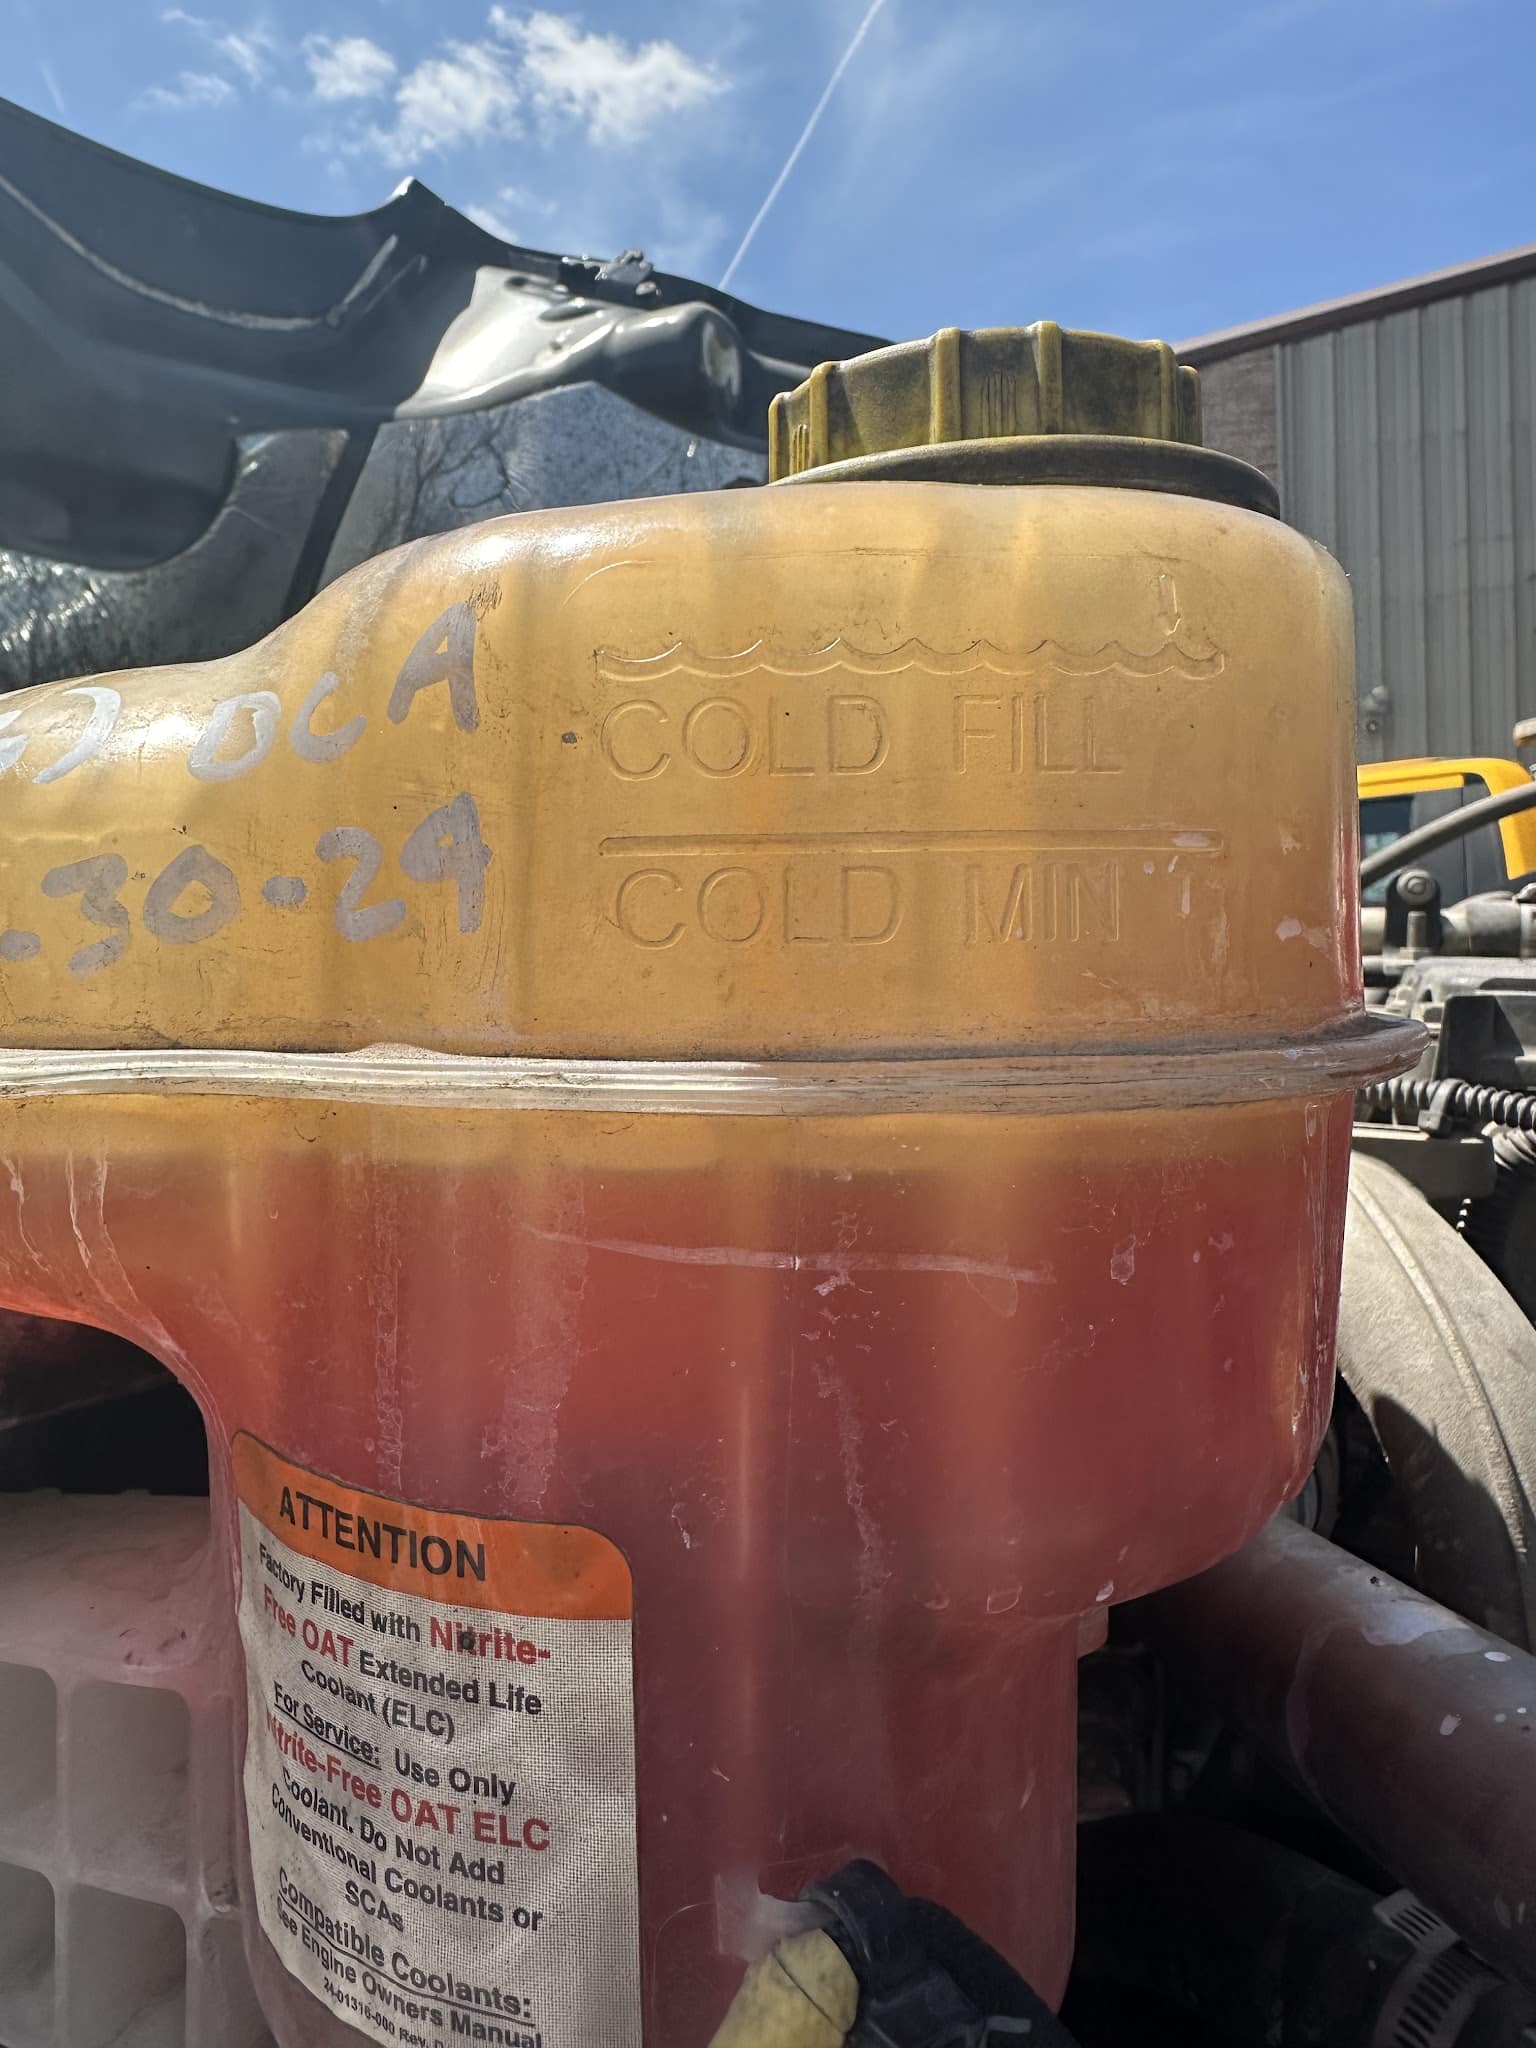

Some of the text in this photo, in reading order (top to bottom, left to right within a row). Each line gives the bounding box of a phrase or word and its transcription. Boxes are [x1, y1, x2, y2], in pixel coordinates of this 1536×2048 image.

[600, 694, 1123, 781] COLD FILL
[616, 862, 1121, 949] COLD MIN
[279, 1486, 487, 1581] ATTENTION
[259, 1544, 305, 1604] Factory
[311, 1581, 365, 1625] Filled
[371, 1610, 421, 1642] with
[264, 1584, 542, 1715] Free OAT Extended Life
[274, 1680, 516, 1806] For Service: Use Only
[301, 1660, 456, 1745] Coolant (ELC)
[271, 1783, 544, 1932] Conventional Coolants or
[361, 1817, 388, 1852] Do
[396, 1834, 440, 1871] Not
[449, 1852, 506, 1885] Add
[391, 1788, 461, 1836] OAT
[473, 1811, 552, 1852] ELC
[279, 1867, 532, 2018] Compatible Coolants:
[345, 1881, 405, 1932] SCAs
[301, 1924, 357, 1984] Engine
[362, 1970, 443, 2027] Owners
[451, 2009, 543, 2048] Manual
